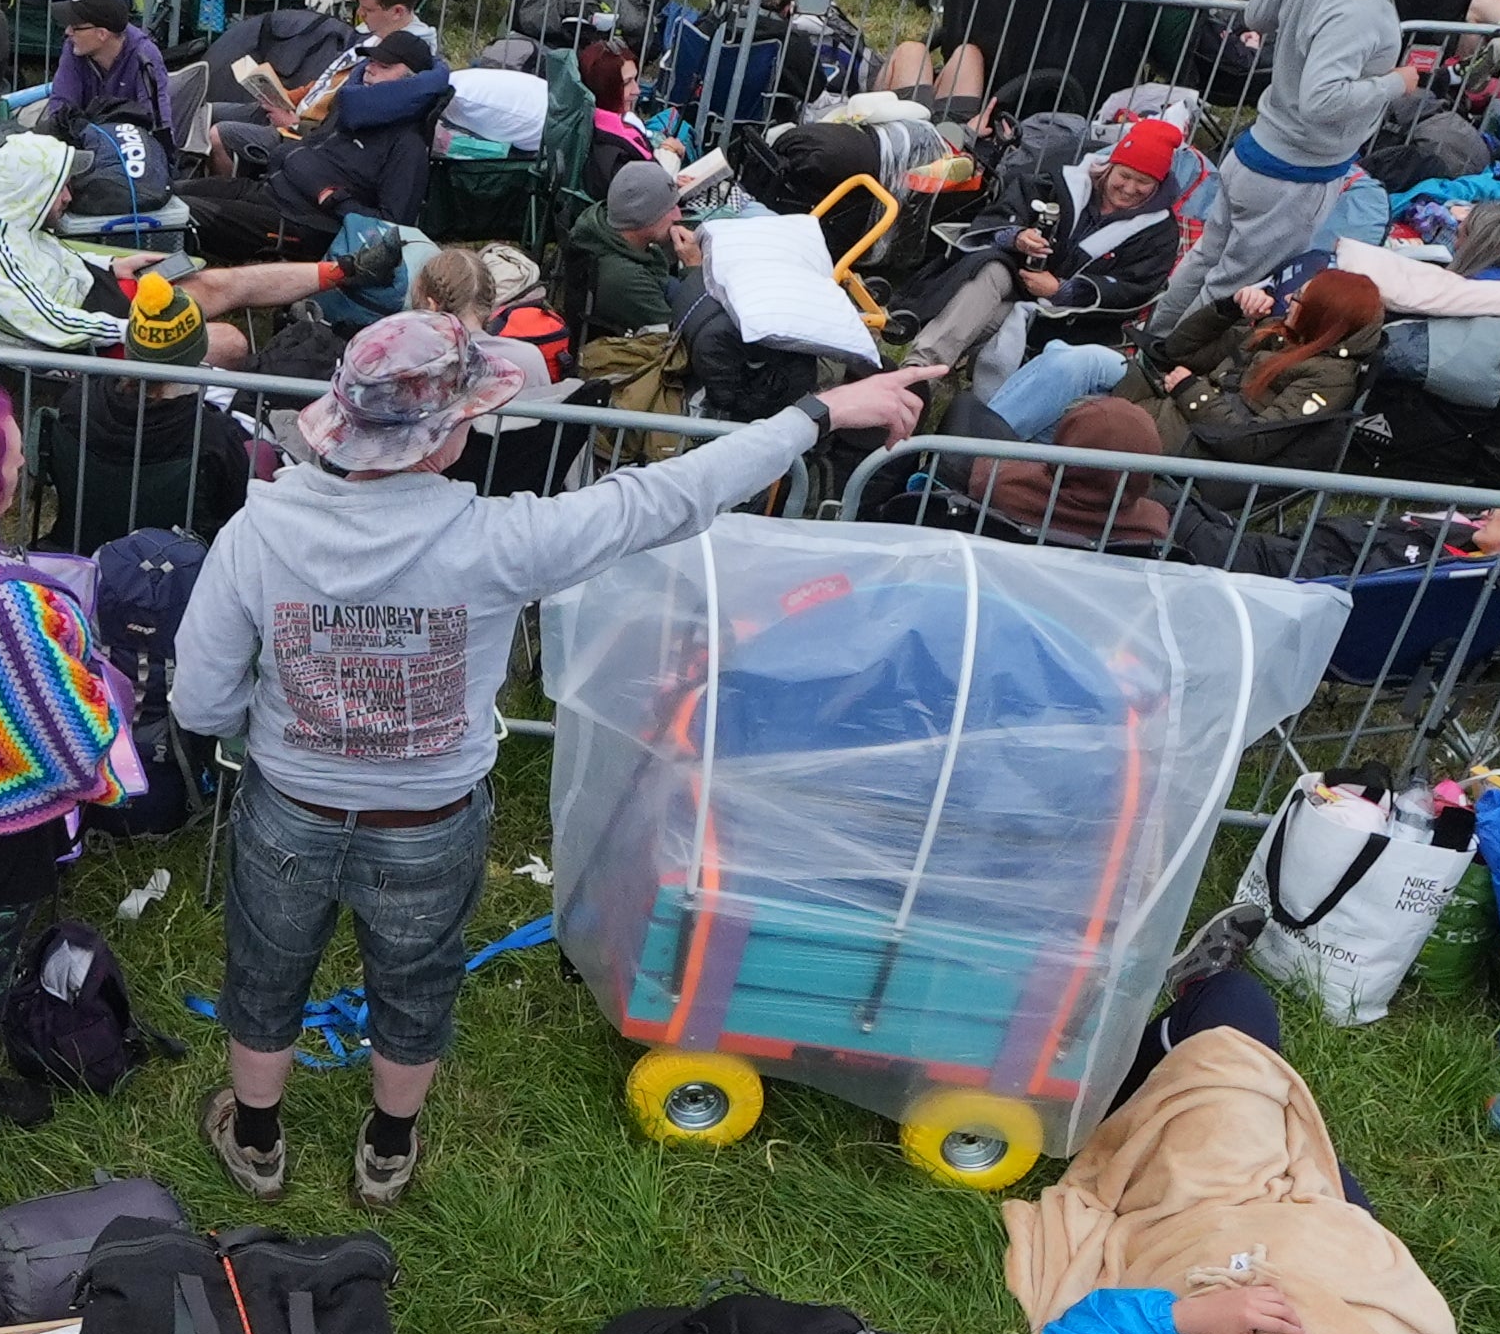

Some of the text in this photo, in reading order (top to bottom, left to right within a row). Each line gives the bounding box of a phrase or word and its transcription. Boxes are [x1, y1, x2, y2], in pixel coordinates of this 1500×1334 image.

[115, 122, 147, 179] adida
[132, 312, 197, 344] ACKERS
[312, 603, 424, 635] GLASTONBURY
[275, 645, 312, 660] BLONDIE
[341, 657, 404, 669] ARCADE FIRE
[341, 667, 404, 679] METALLICA
[341, 678, 405, 691] KASABIAN
[342, 690, 369, 701] JACK
[346, 705, 406, 718] ELBOW
[1404, 876, 1439, 891] NIKE
[1400, 888, 1447, 905] HOUSE
[1281, 925, 1358, 964] NNOVATION
